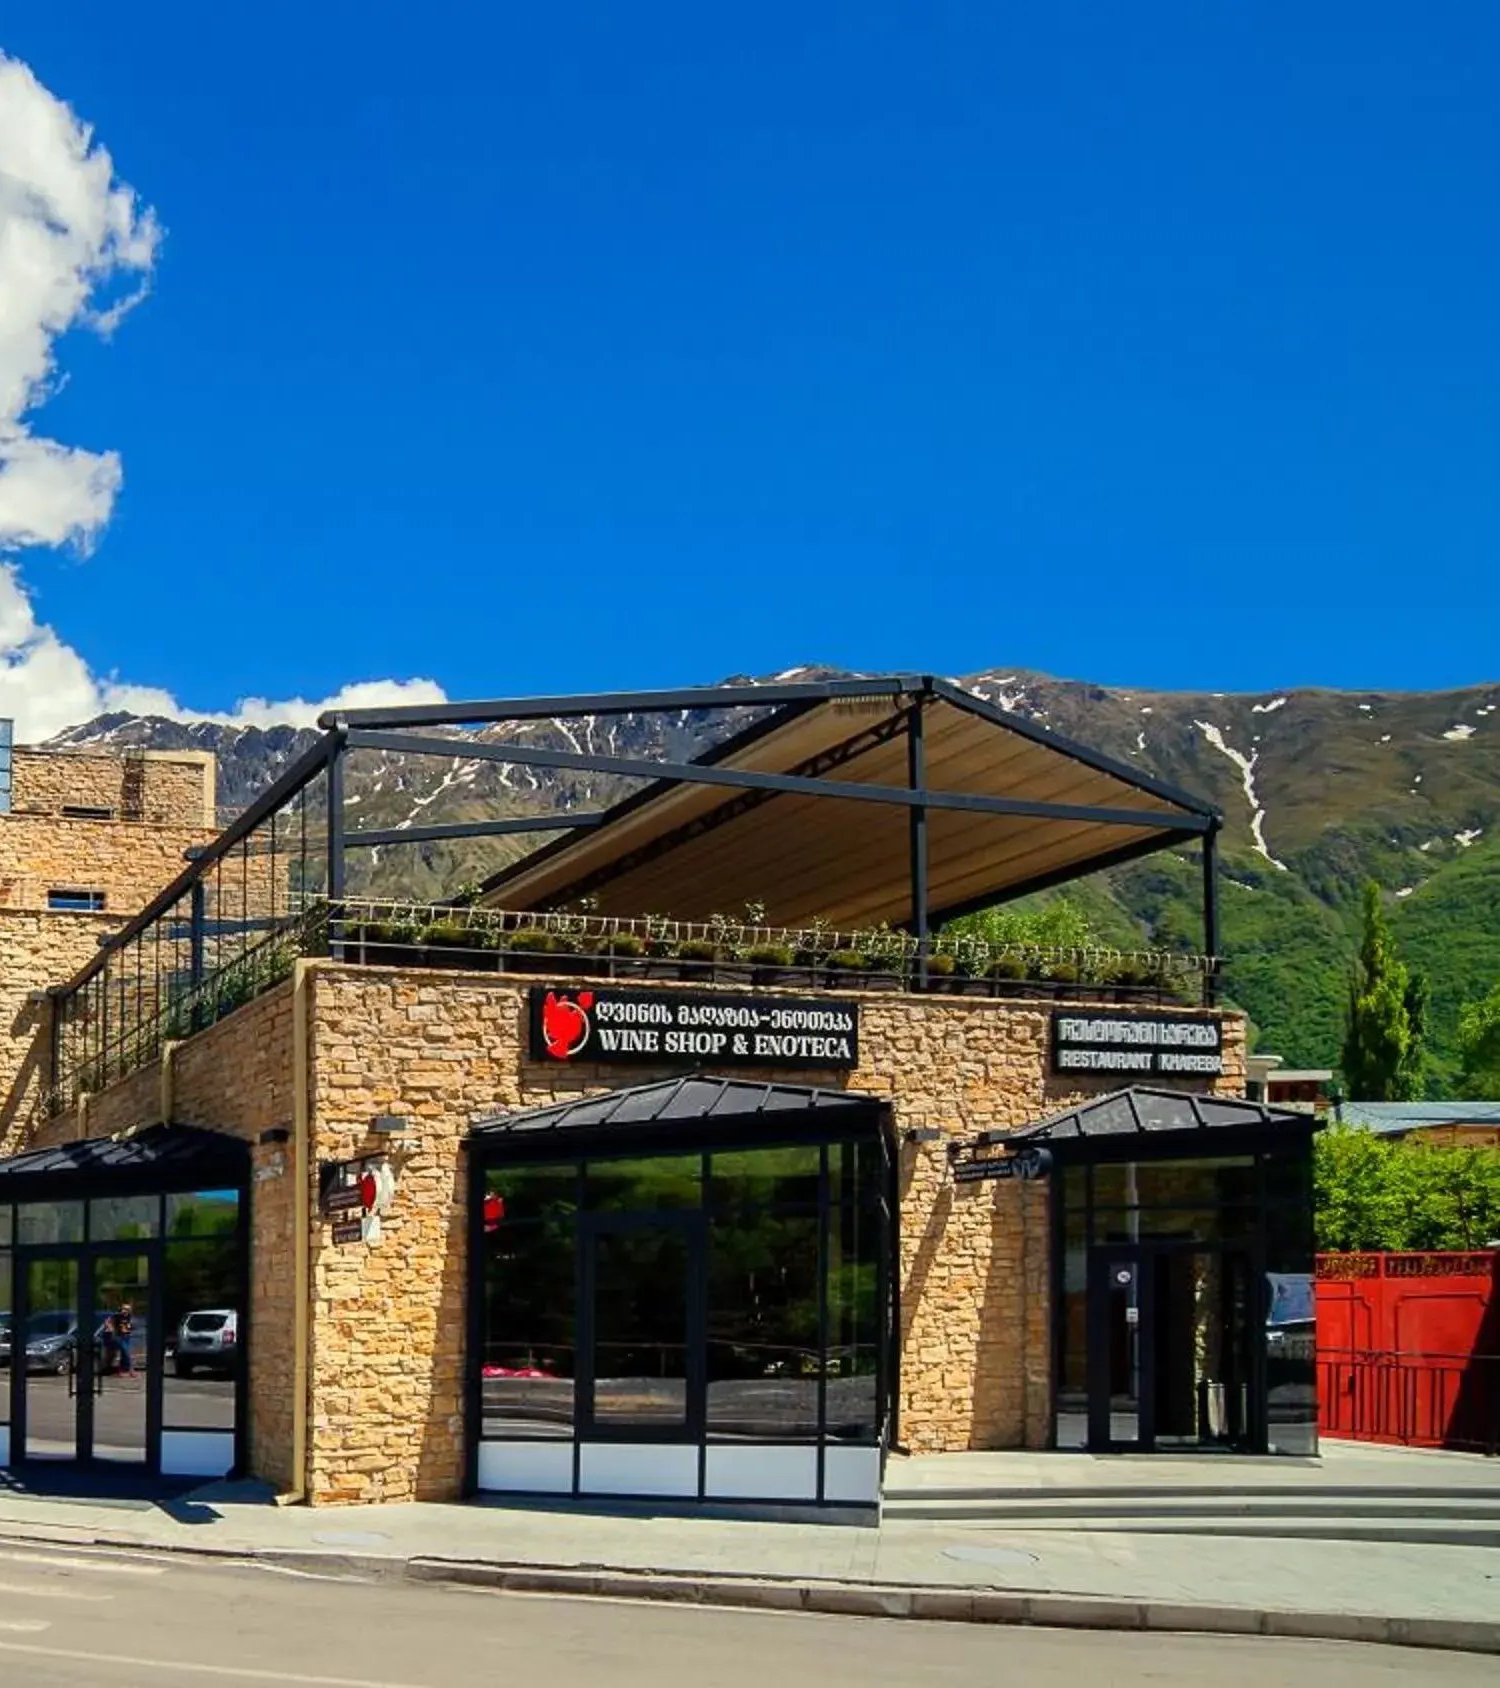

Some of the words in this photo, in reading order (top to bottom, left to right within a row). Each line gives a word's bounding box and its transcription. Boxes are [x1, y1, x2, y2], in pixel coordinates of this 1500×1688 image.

[597, 1029, 659, 1052] WINE
[664, 1031, 726, 1054] SHOP
[732, 1035, 749, 1056] &
[754, 1035, 851, 1059] ENOTECA
[1059, 1050, 1153, 1069] RESTAURANT
